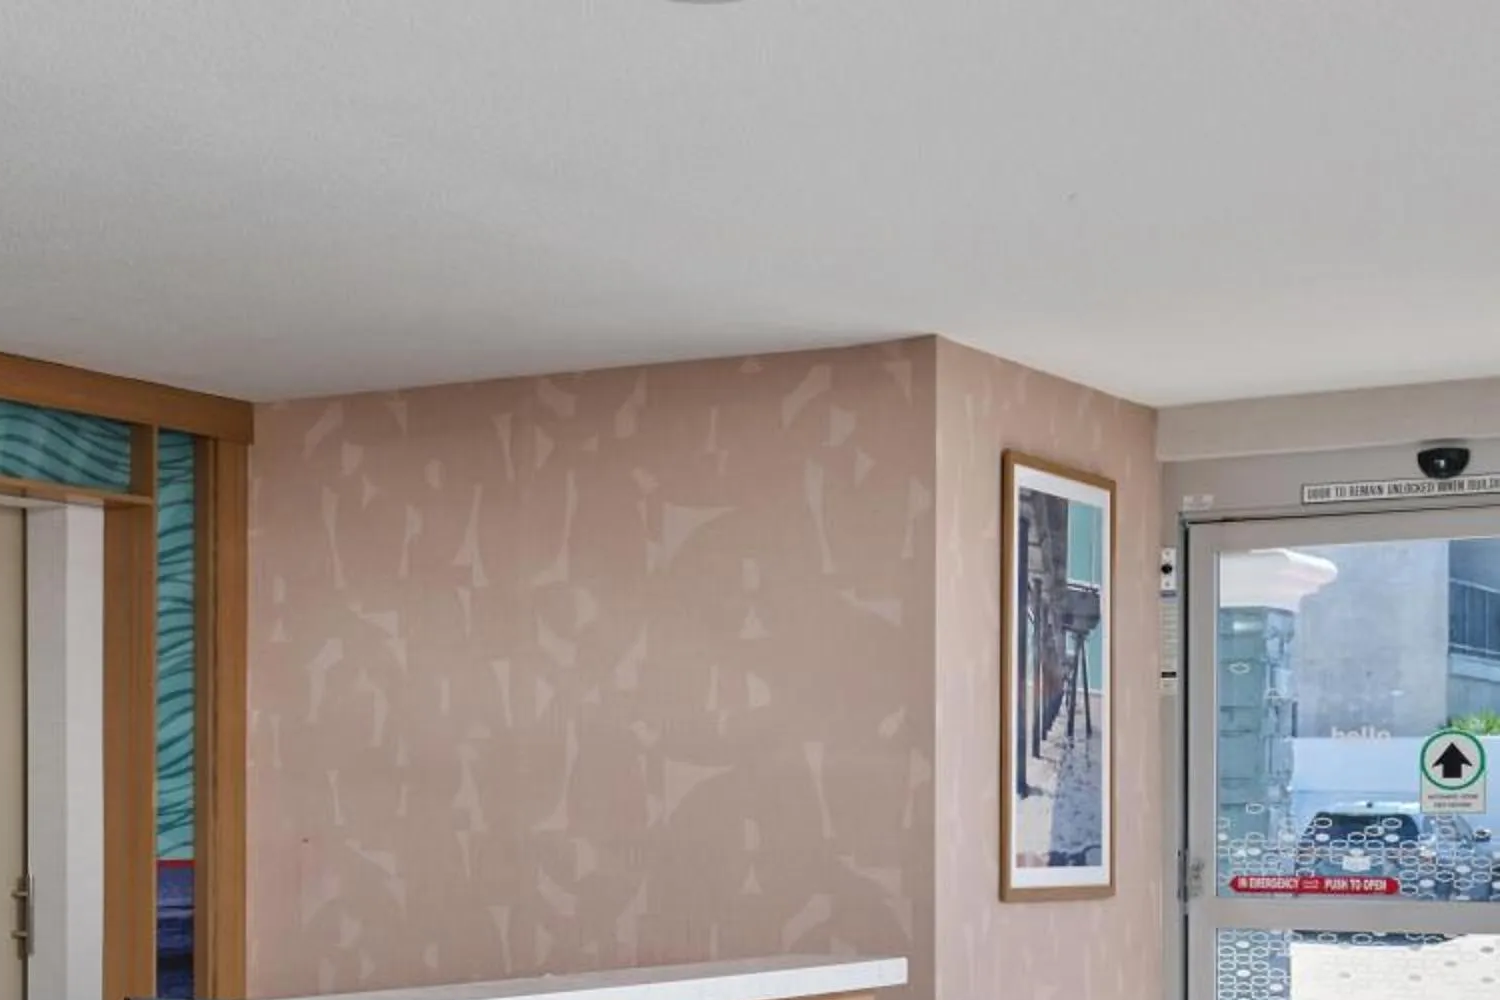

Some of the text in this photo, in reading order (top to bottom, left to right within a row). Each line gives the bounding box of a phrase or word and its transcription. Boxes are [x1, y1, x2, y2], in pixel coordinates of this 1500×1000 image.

[1249, 877, 1299, 889] EMERGENCY
[1324, 878, 1348, 890] PUSH
[1350, 878, 1361, 890] TO
[1363, 878, 1387, 890] OPEN
